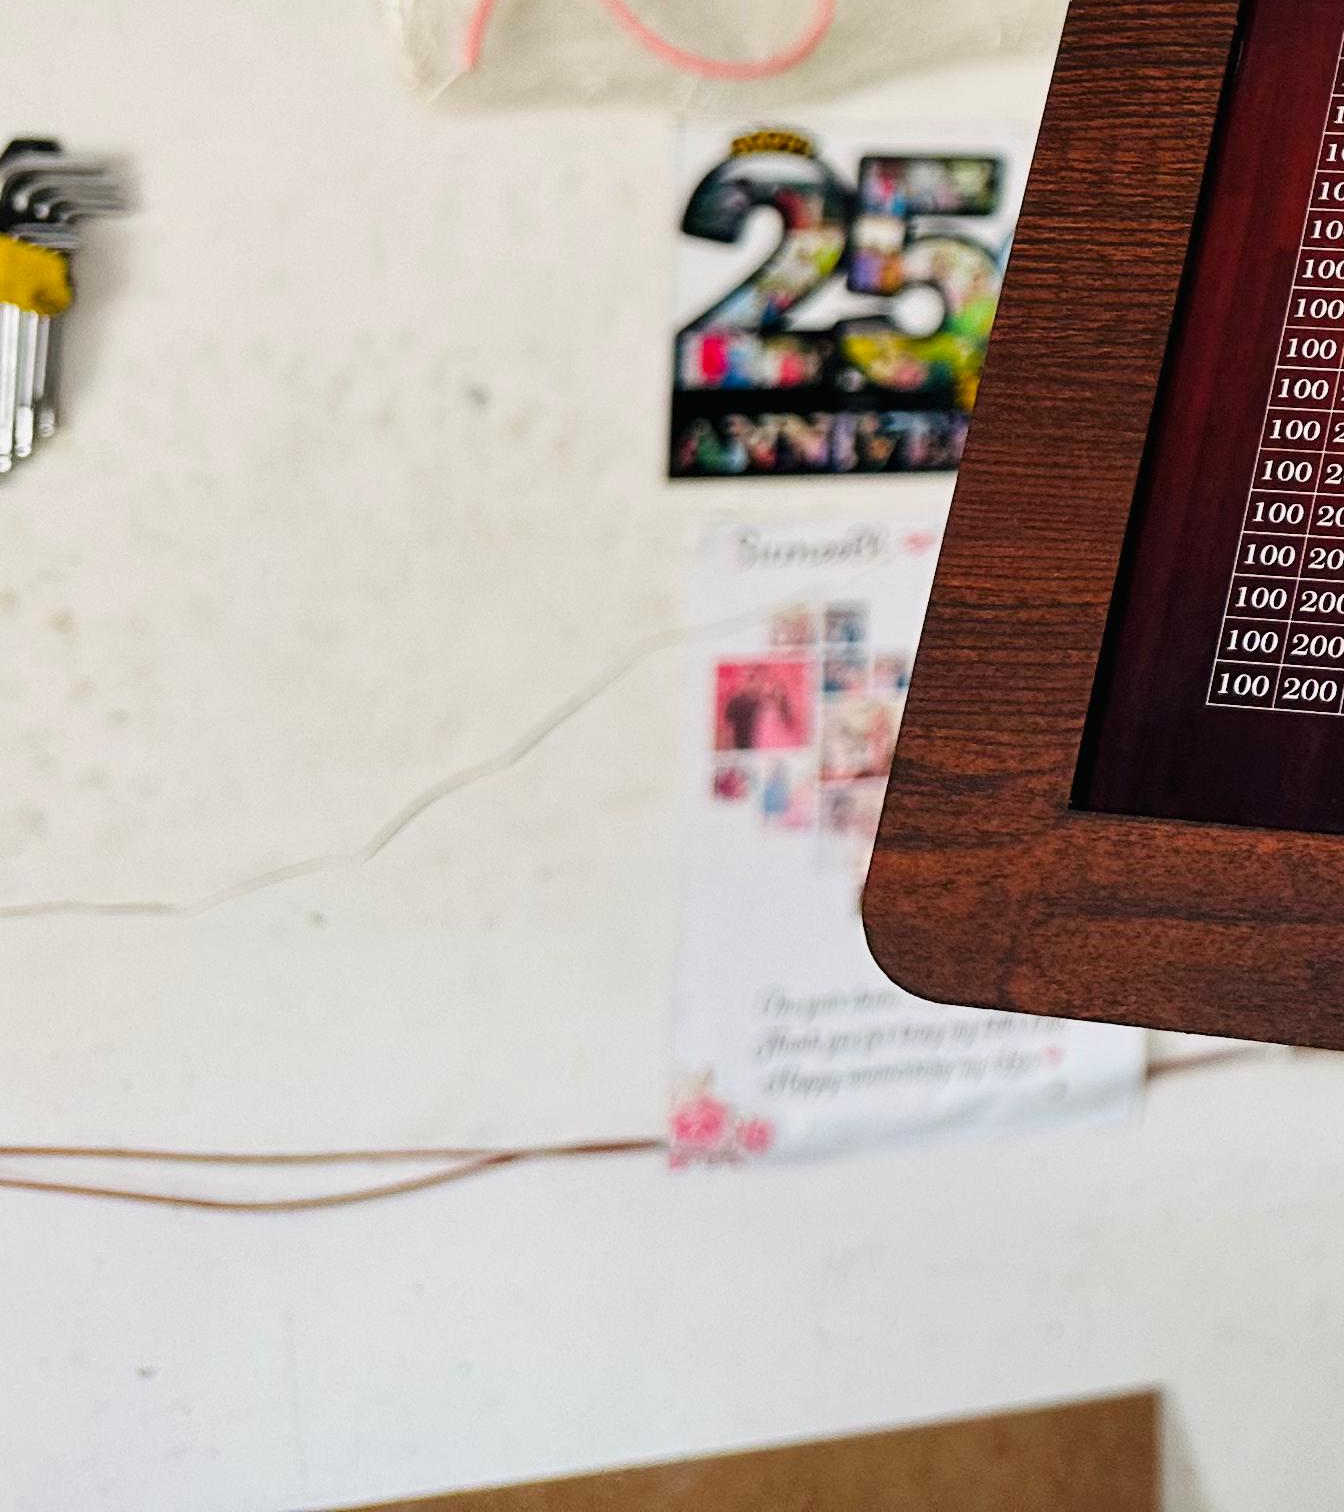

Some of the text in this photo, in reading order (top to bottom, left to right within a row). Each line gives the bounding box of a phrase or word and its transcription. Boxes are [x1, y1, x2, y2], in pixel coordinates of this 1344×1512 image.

[1277, 378, 1329, 400] 100
[1244, 543, 1296, 567] 100
[1217, 672, 1270, 697] 100
[1282, 677, 1338, 703] 200
